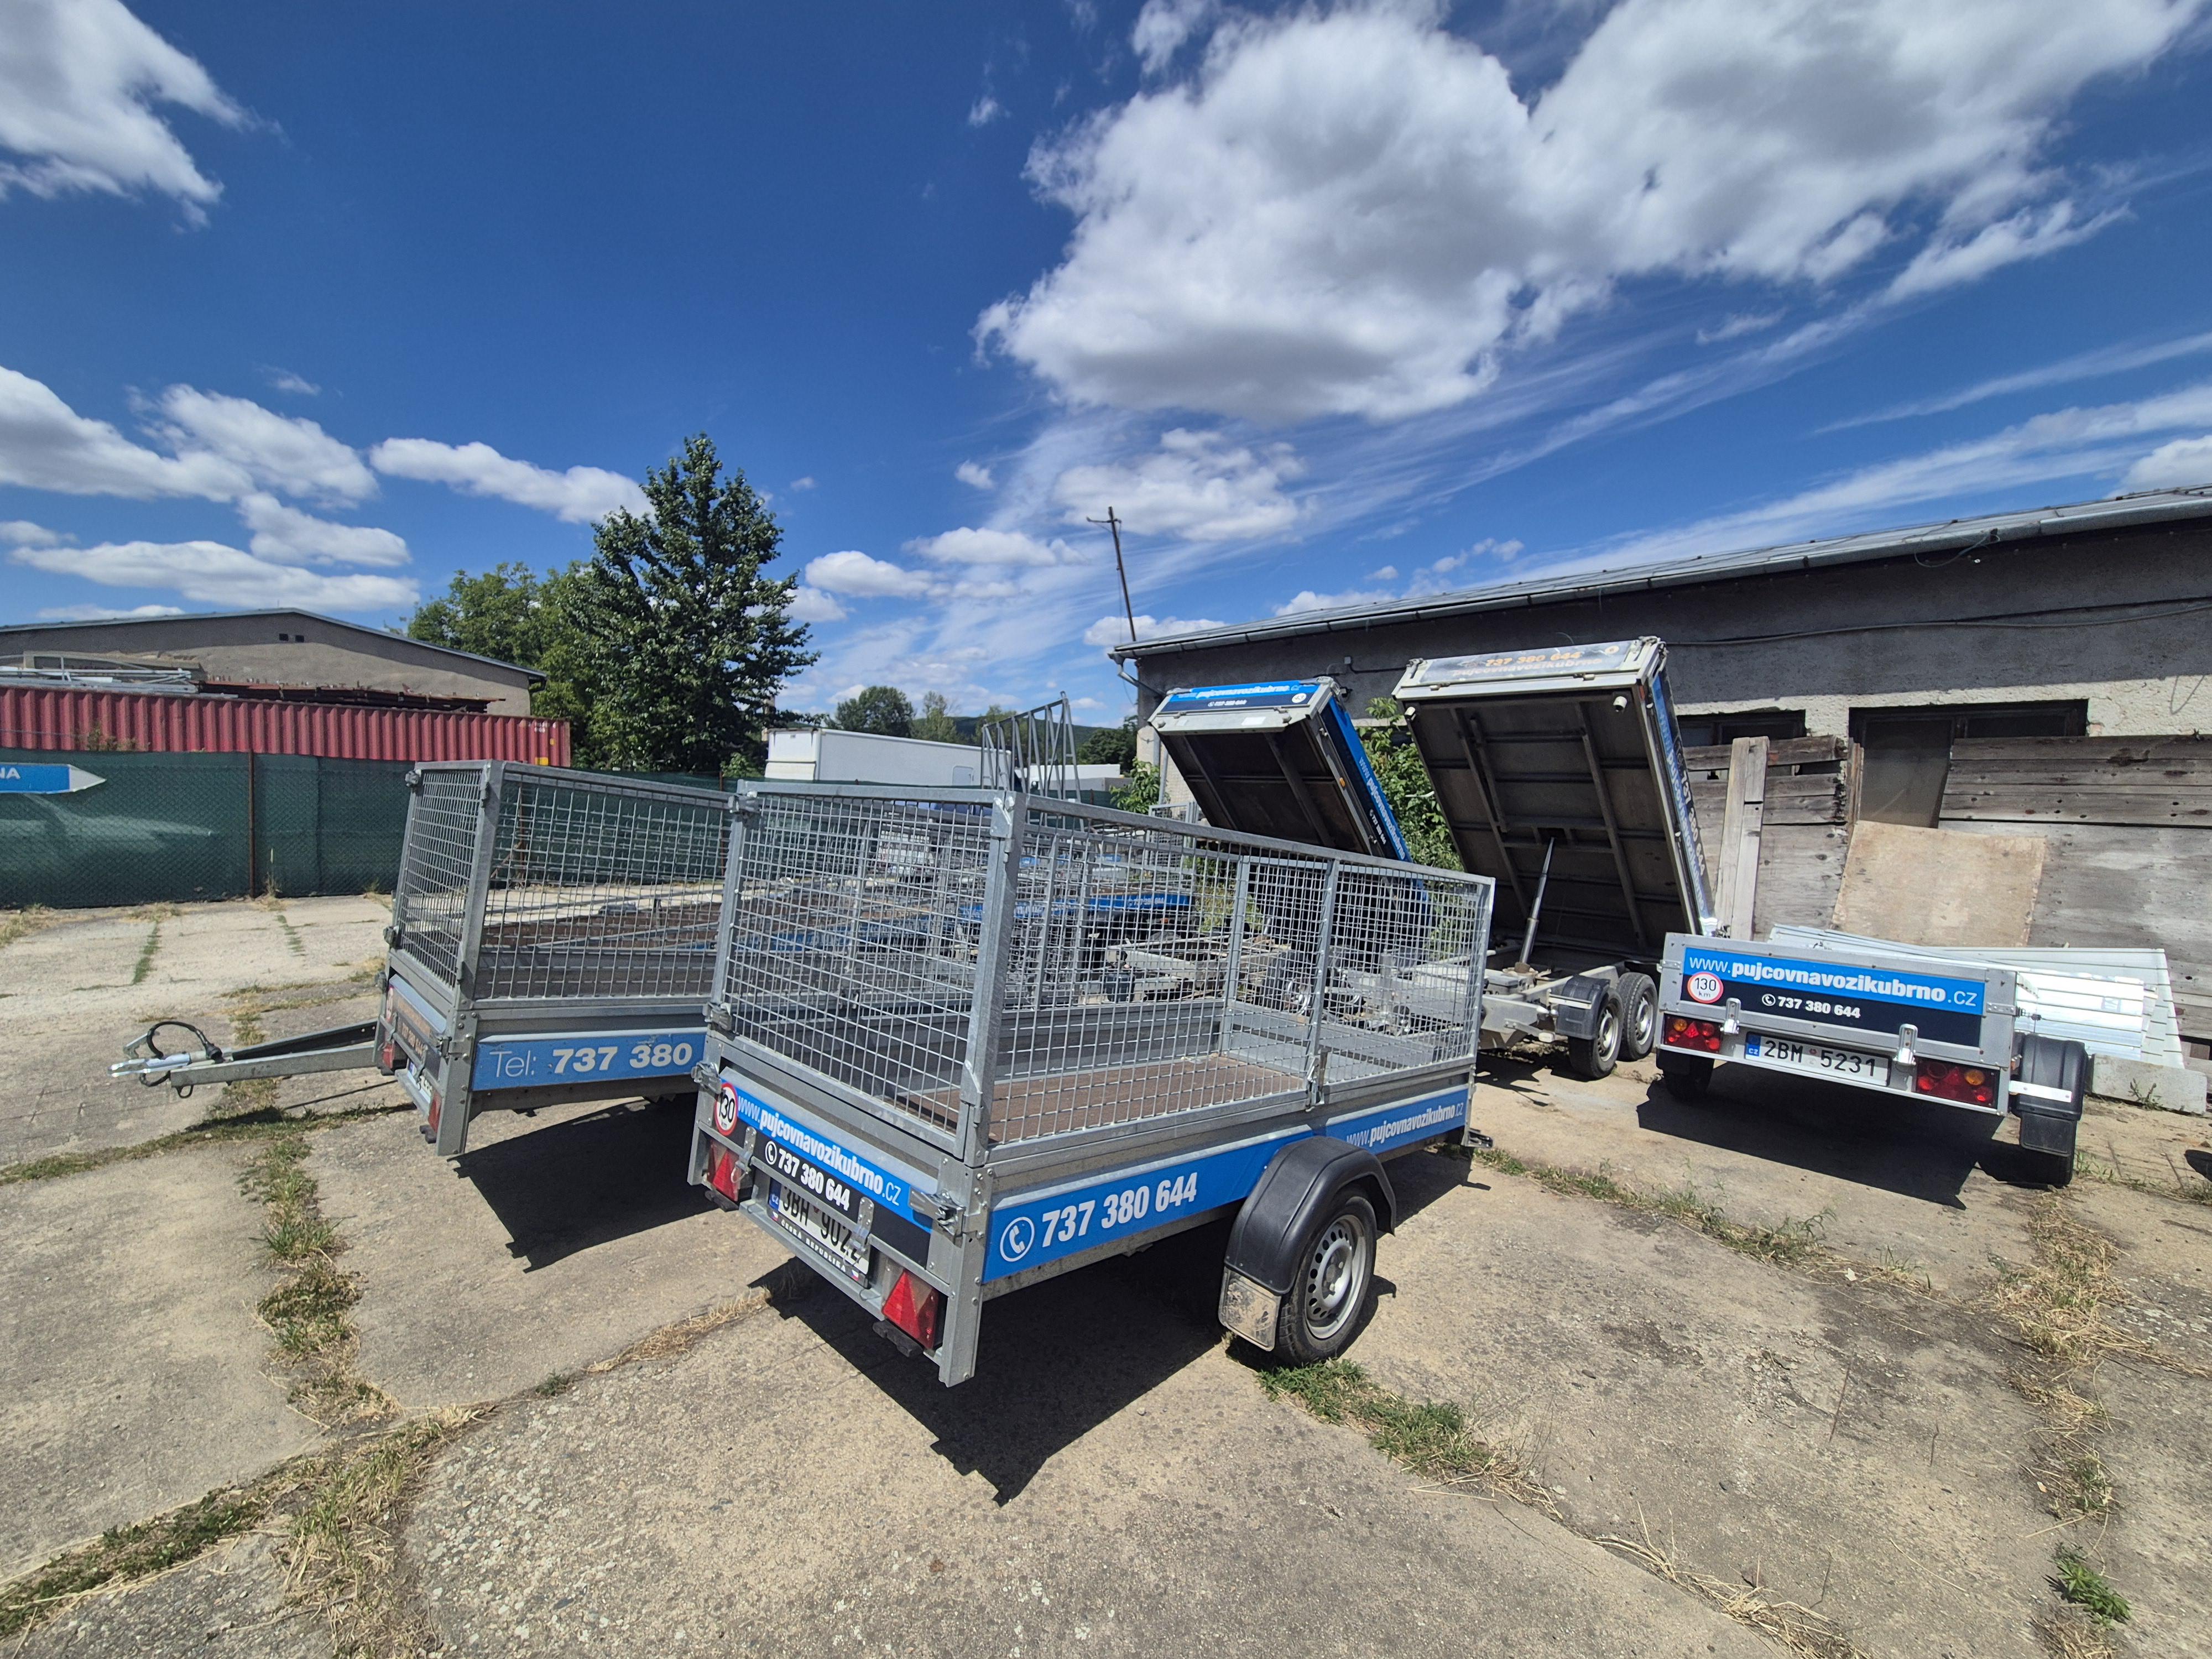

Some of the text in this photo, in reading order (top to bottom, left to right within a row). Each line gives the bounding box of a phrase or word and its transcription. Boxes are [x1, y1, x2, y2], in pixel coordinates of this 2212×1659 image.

[1689, 956, 1978, 1007] www.pujcovnavozikubrno.cz
[1695, 977, 1717, 991] 130
[1778, 996, 1861, 1019] 737 380 644
[489, 1042, 692, 1078] Tel: 737 380
[1764, 1040, 1875, 1077] 2BM 5231
[738, 1095, 902, 1206] www.pujcovnavozikubrno.cz
[779, 1148, 850, 1211] 737 380 644
[1042, 1172, 1198, 1248] 737 380 644
